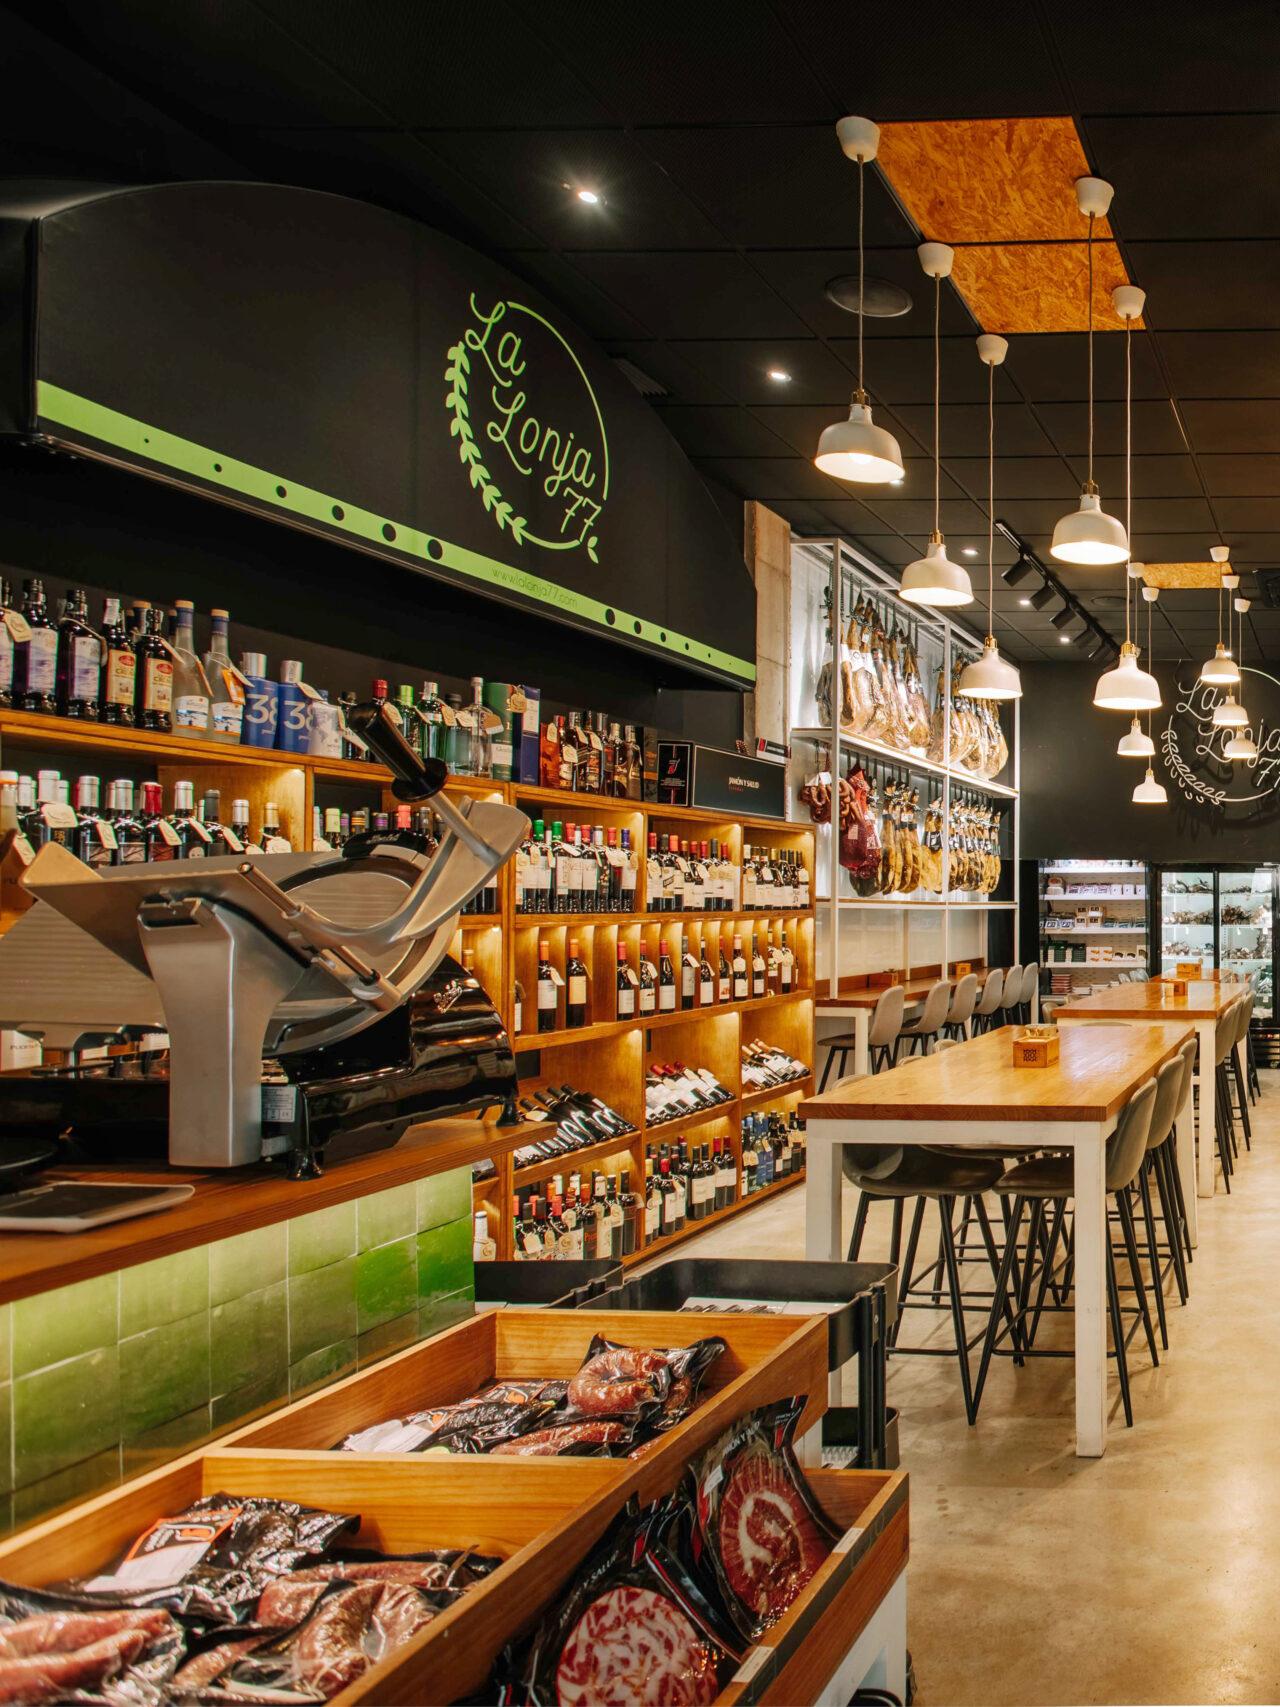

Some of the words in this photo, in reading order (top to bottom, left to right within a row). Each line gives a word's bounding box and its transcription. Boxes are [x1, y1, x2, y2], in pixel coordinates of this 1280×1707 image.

[465, 292, 526, 387] La
[487, 385, 595, 496] Lonja
[561, 486, 601, 543] 77
[1176, 676, 1223, 721] La
